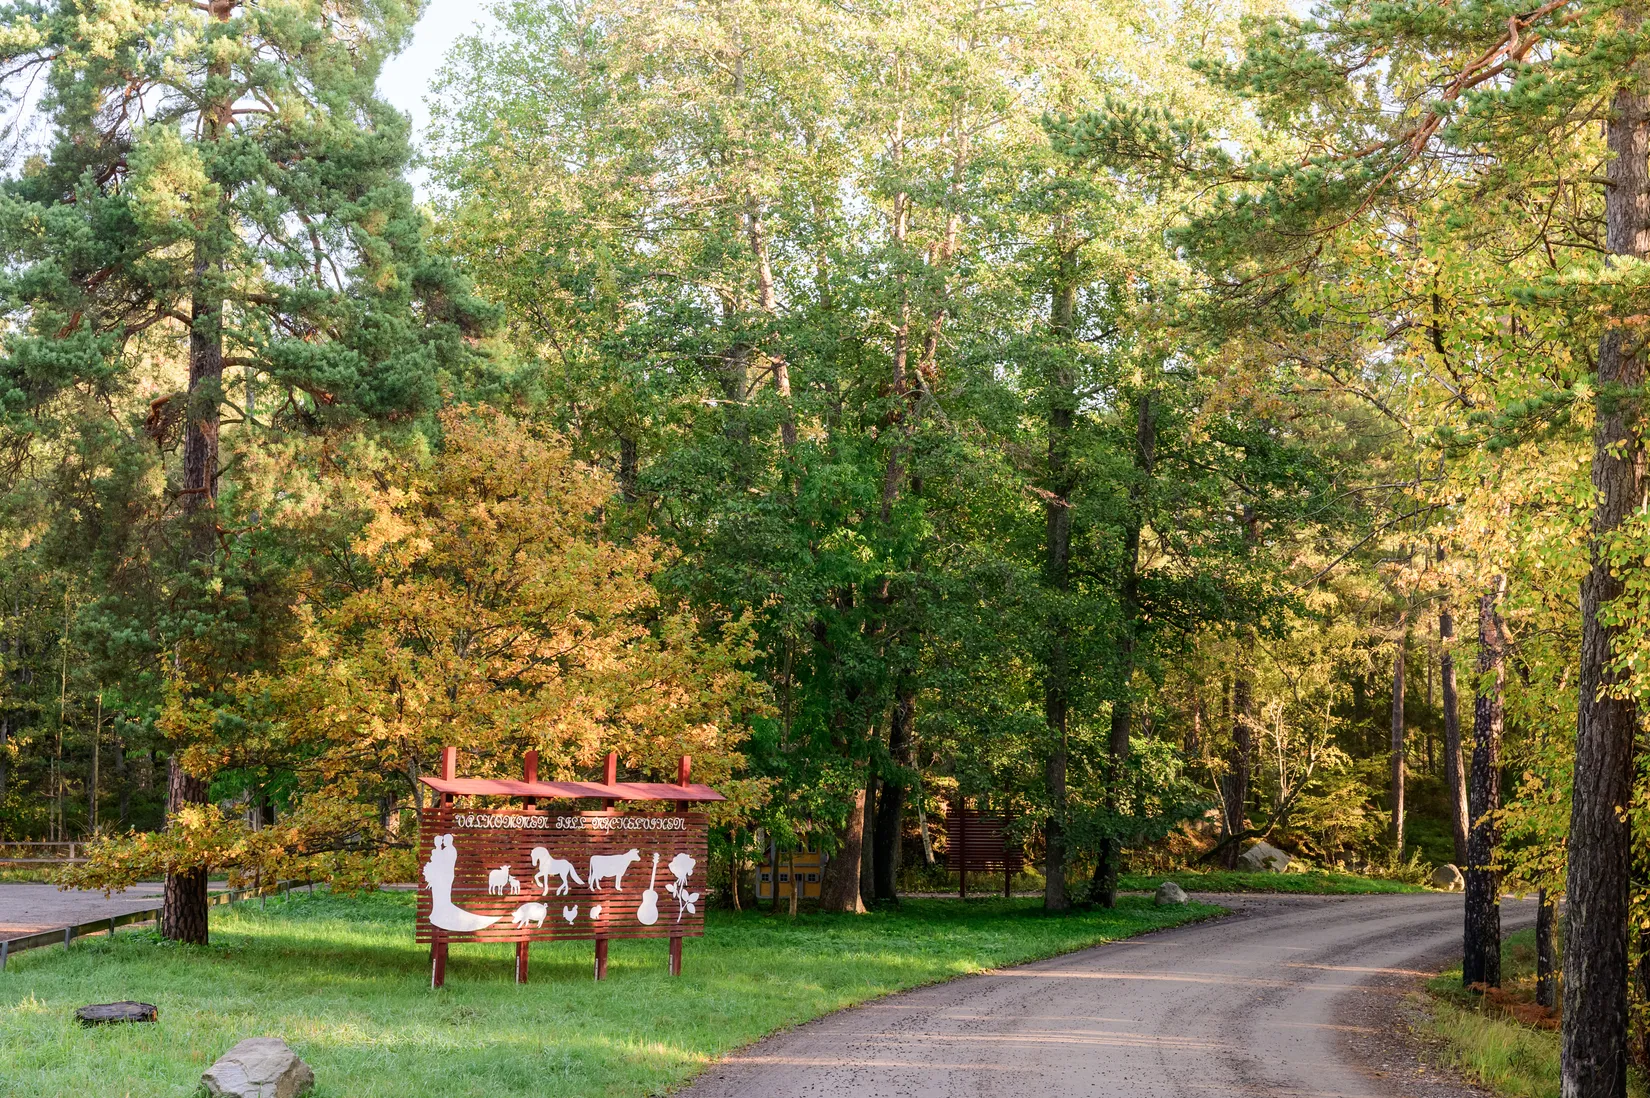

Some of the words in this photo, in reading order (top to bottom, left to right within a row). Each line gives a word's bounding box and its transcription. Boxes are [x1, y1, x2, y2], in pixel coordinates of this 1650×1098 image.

[454, 811, 550, 829] VÄLKOMMEN
[555, 815, 587, 829] TILL
[591, 816, 687, 834] NYCKELVIKEN
